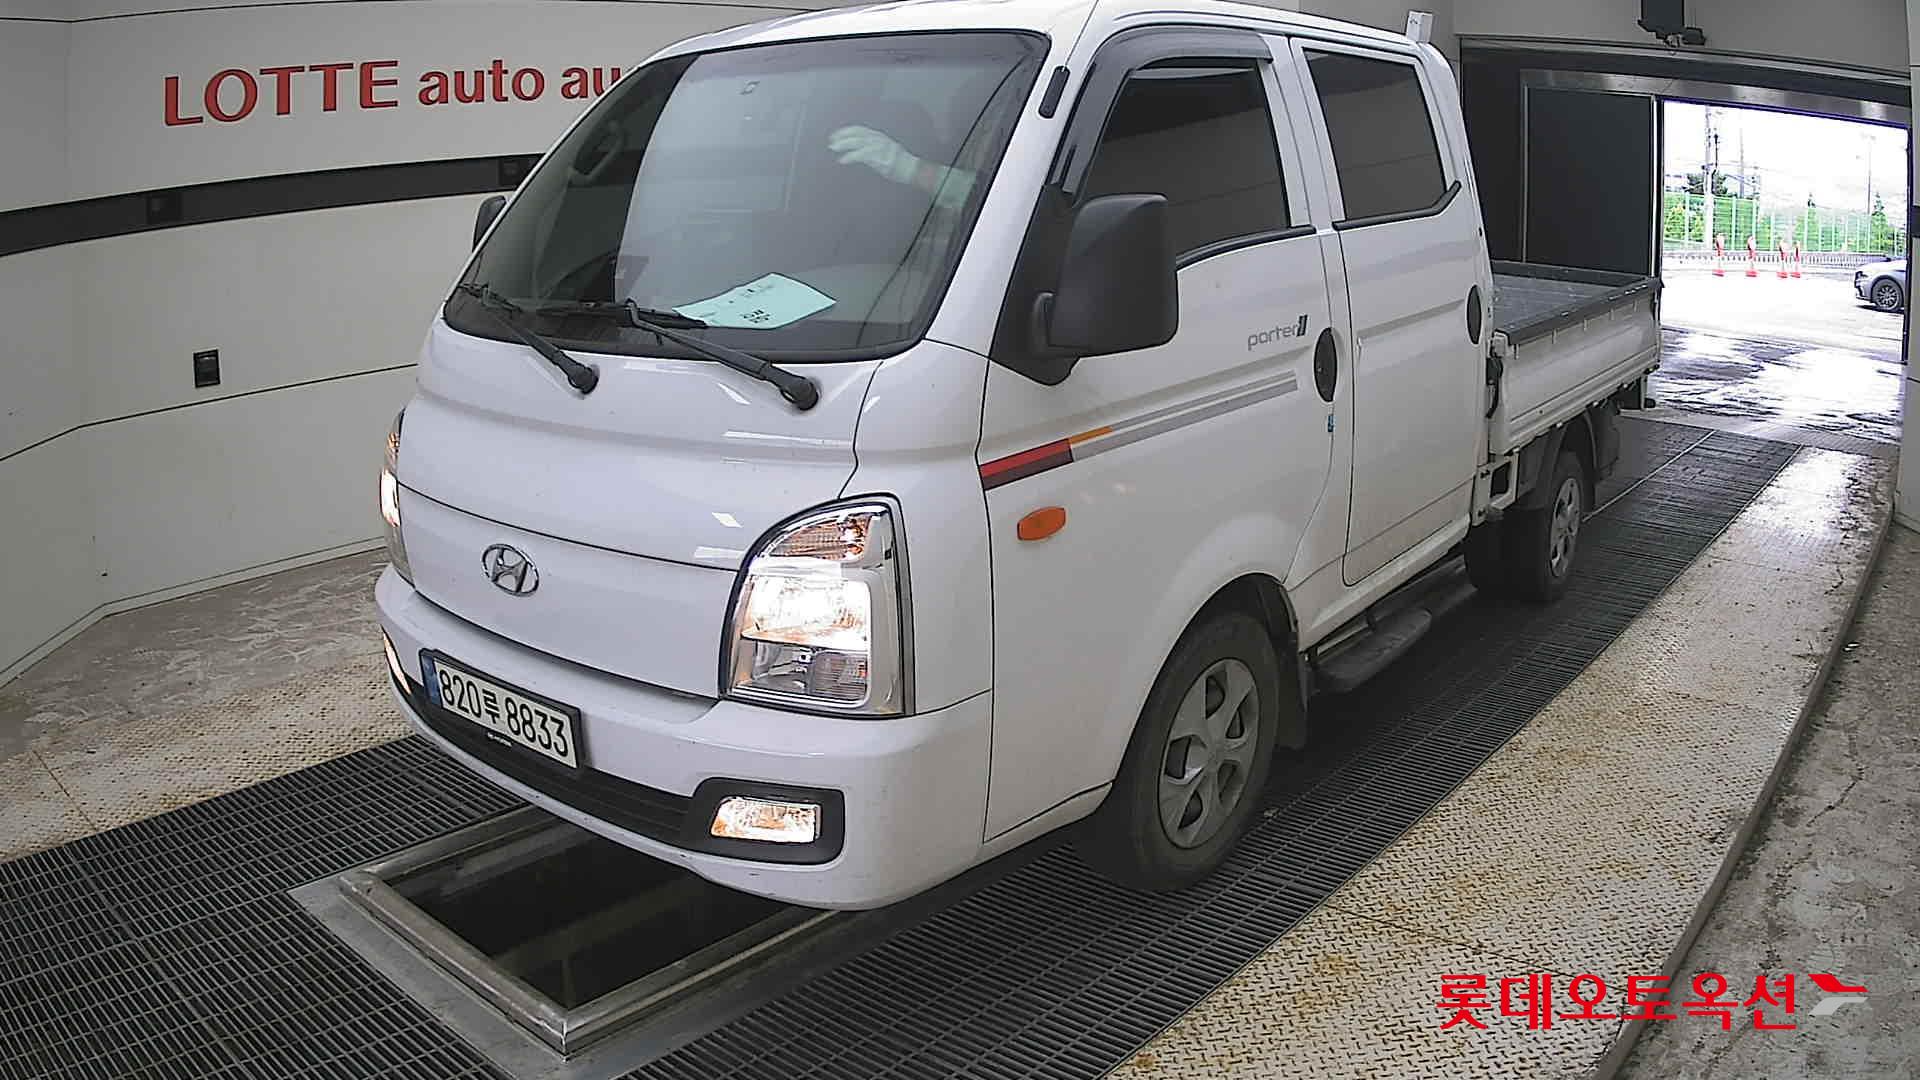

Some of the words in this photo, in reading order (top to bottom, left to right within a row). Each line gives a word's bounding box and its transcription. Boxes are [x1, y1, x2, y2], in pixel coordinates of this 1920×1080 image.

[164, 60, 399, 126] LOTTE
[418, 59, 545, 106] auto
[505, 696, 569, 757] 8833
